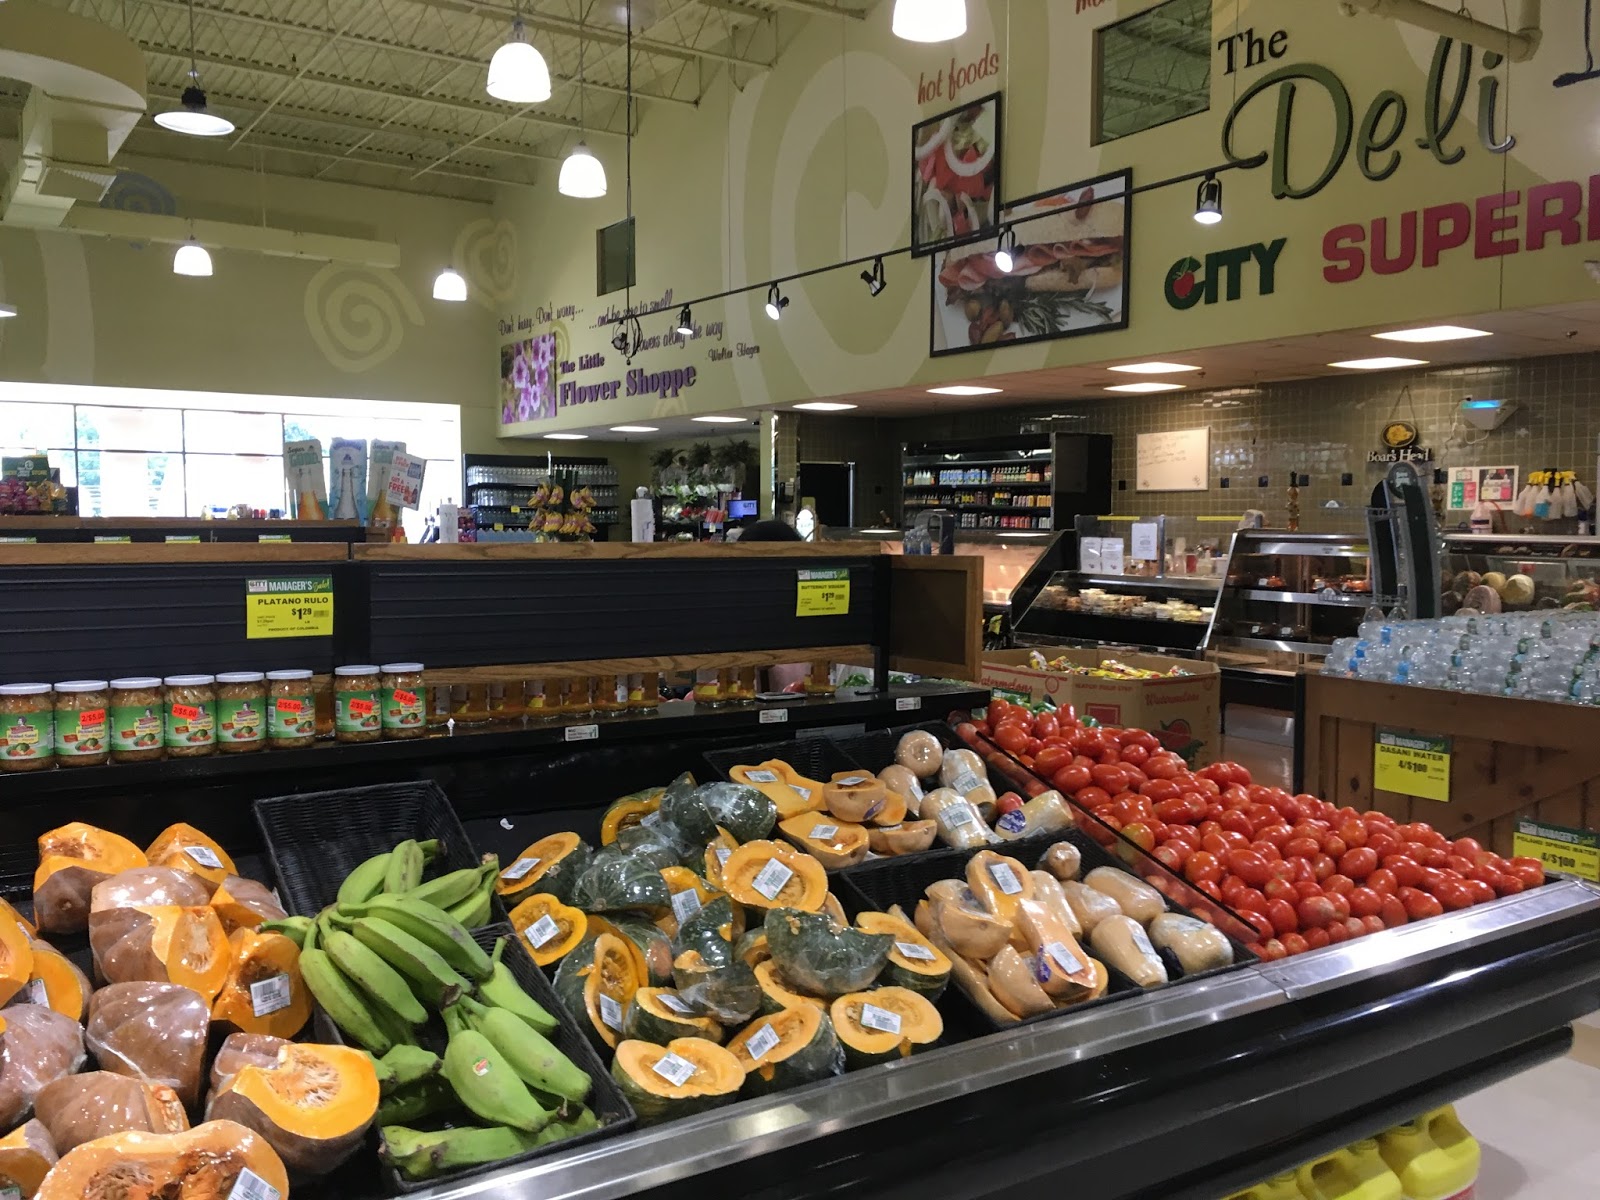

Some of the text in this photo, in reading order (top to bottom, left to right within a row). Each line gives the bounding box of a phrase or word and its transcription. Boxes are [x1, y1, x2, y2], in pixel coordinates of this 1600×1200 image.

[1218, 28, 1288, 76] The
[918, 43, 999, 105] hot foods
[1221, 35, 1515, 199] Deli
[1164, 237, 1287, 310] CITY
[706, 322, 724, 341] way
[560, 352, 605, 374] The Little
[559, 366, 697, 407] Flower Shoppe
[1367, 445, 1429, 462] Boar's Head
[389, 482, 406, 494] FREE
[269, 581, 313, 592] MANAGER'S
[257, 596, 329, 605] PLATANO RULO
[81, 712, 105, 722] 2/$5.00
[173, 706, 197, 718] 2/$5.00
[1380, 745, 1444, 762] DASANI WATER
